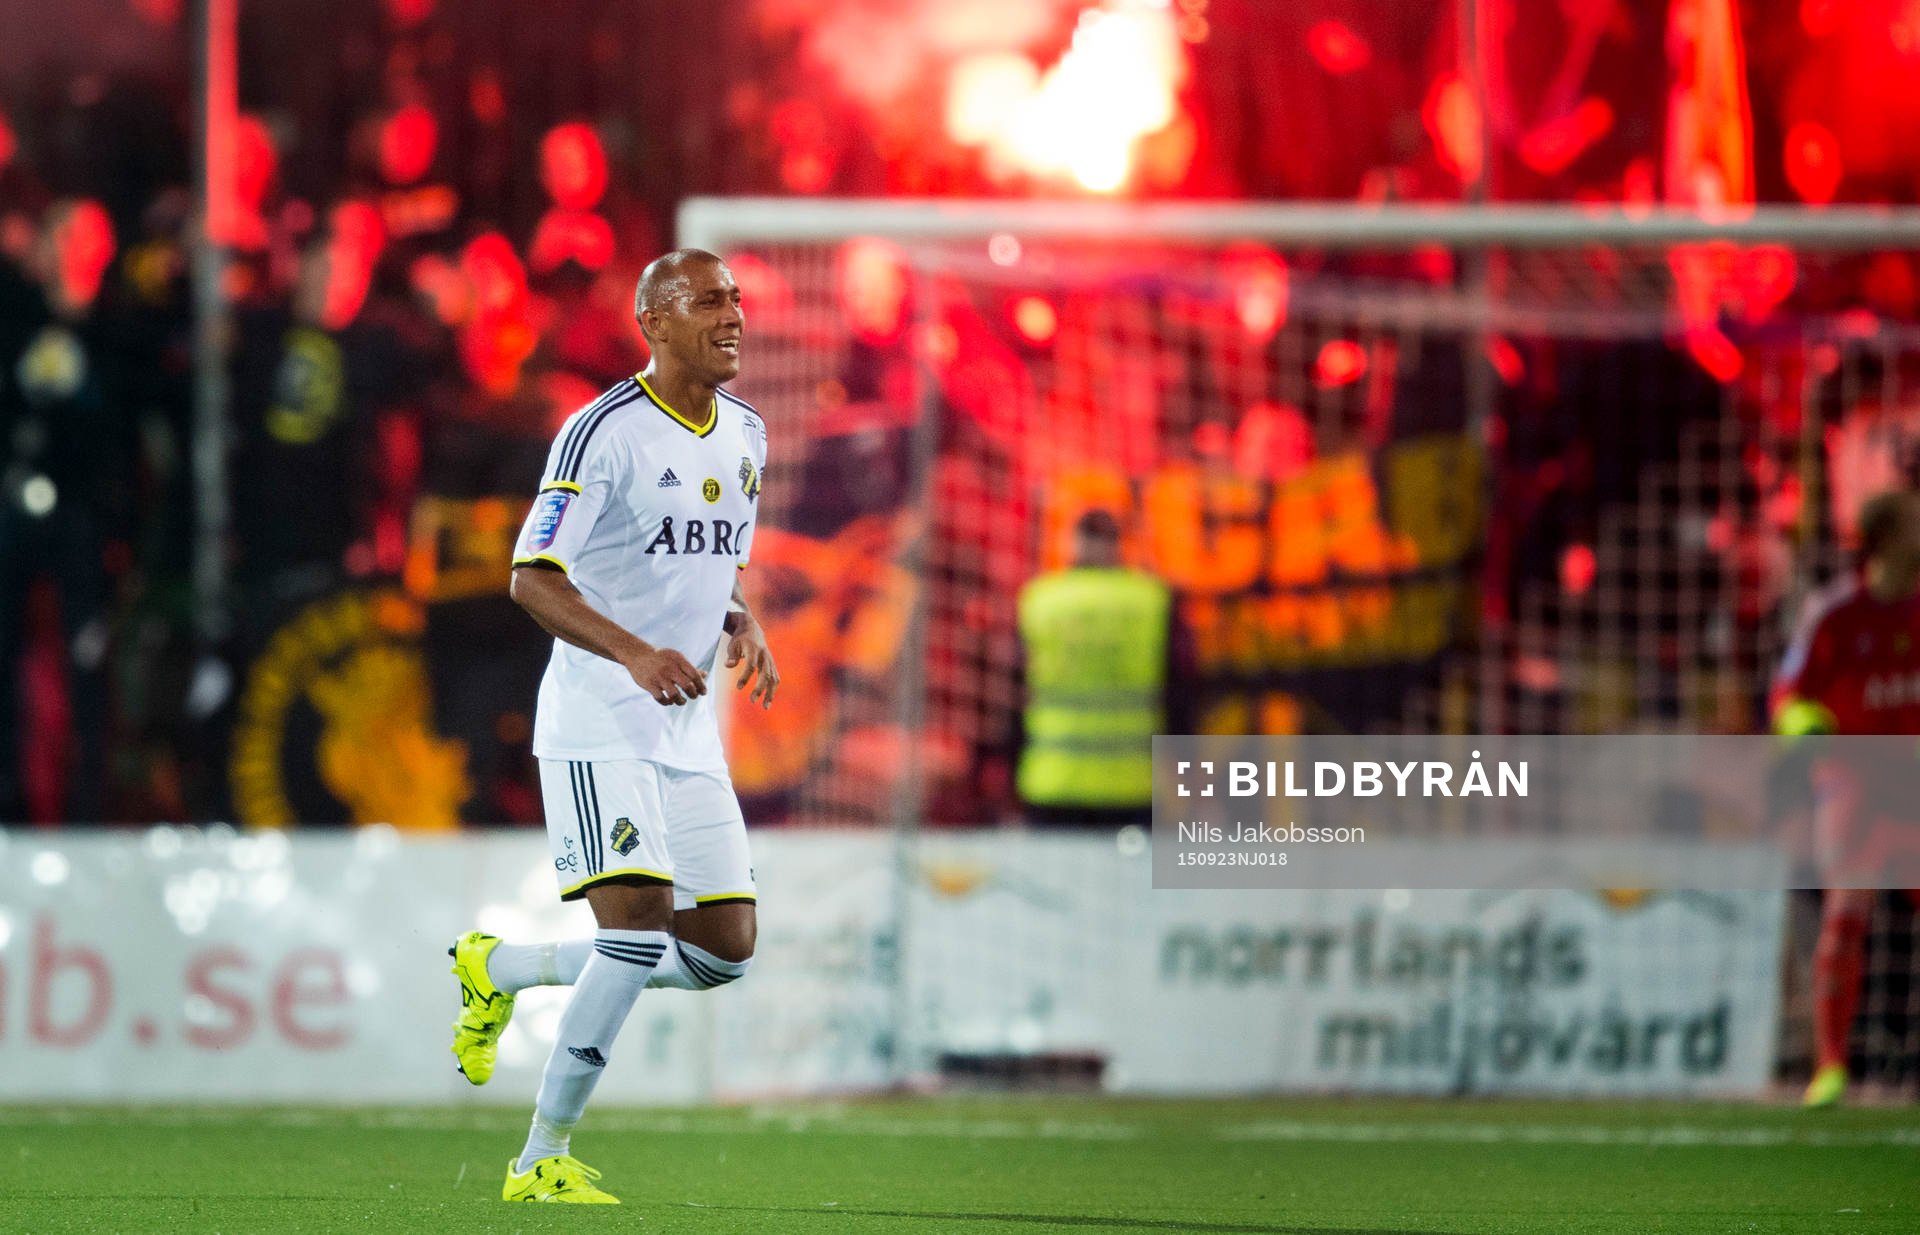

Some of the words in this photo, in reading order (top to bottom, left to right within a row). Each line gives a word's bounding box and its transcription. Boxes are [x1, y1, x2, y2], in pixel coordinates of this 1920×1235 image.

[705, 485, 716, 496] 27
[0, 908, 352, 1052] b.se
[1160, 903, 1588, 985] norrlands
